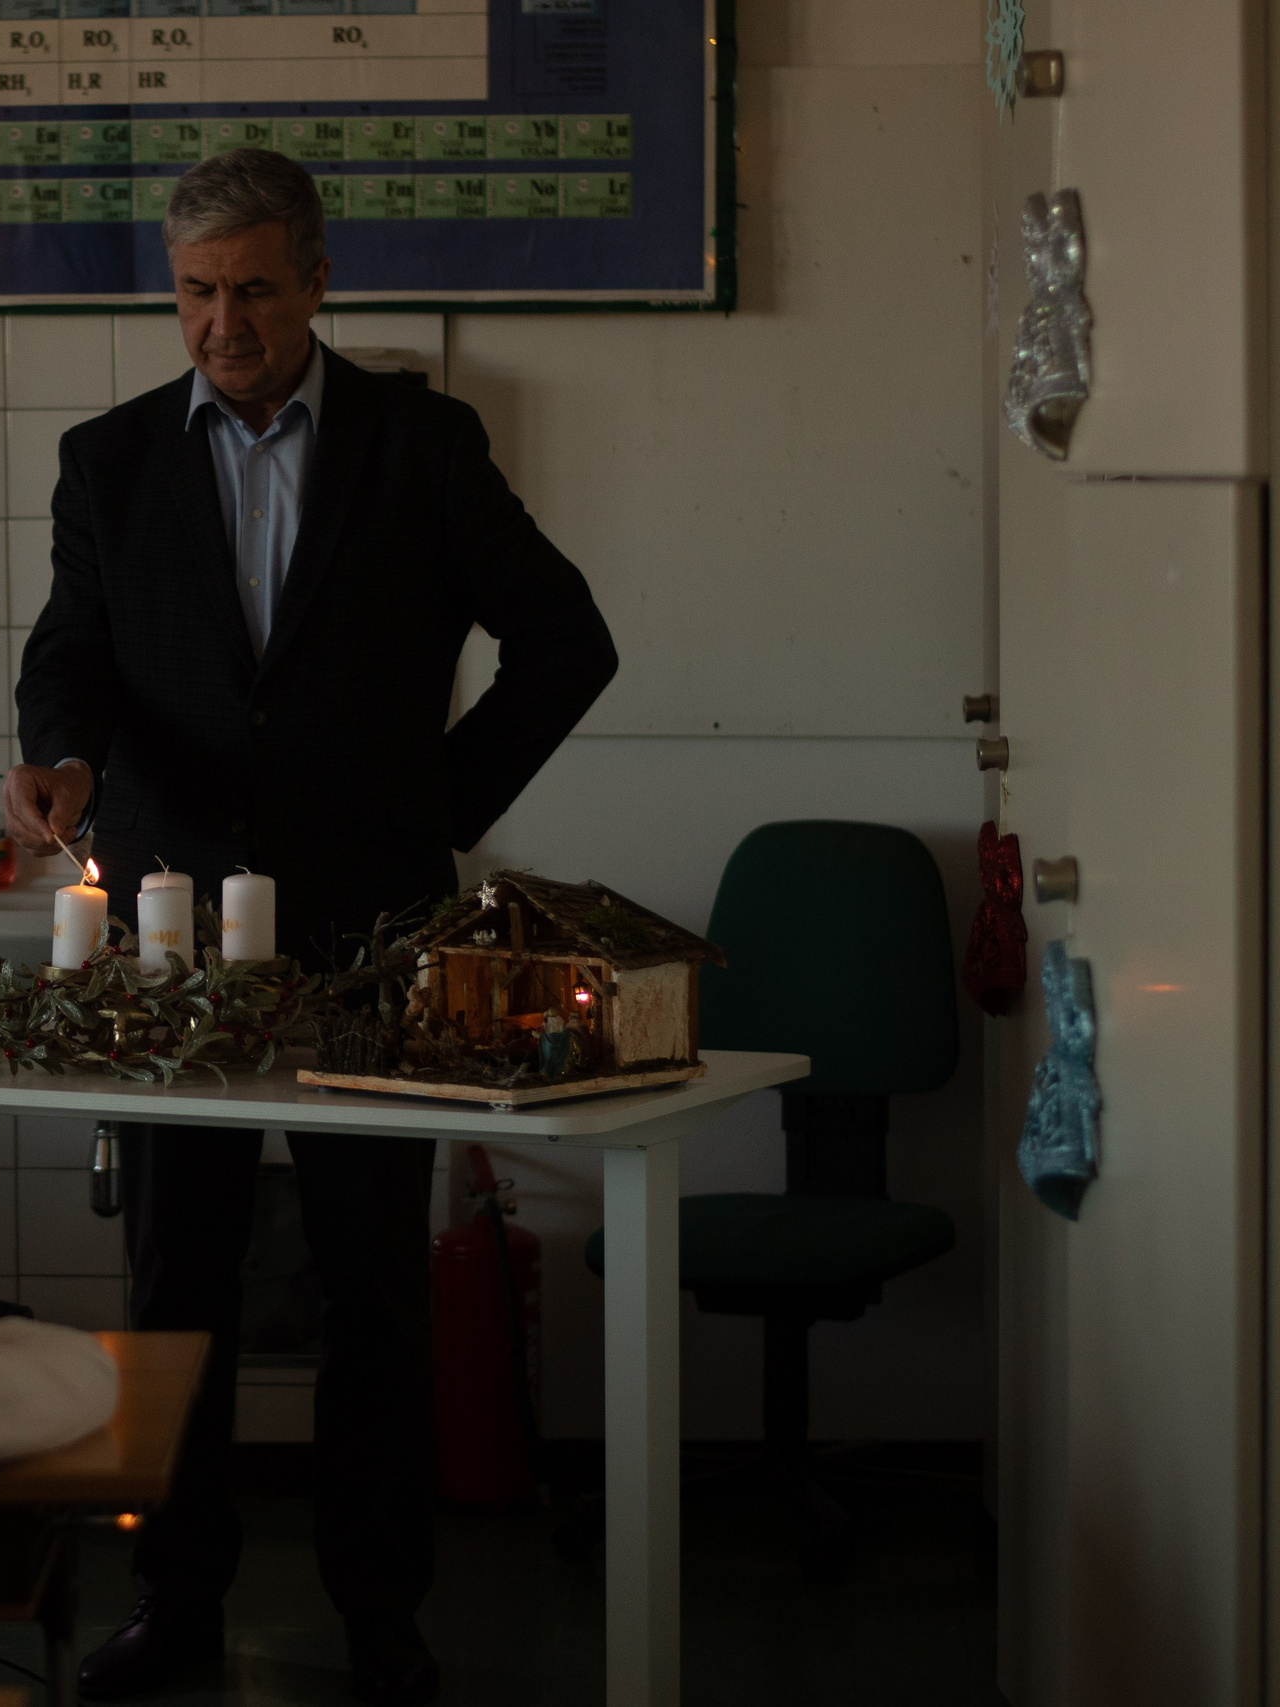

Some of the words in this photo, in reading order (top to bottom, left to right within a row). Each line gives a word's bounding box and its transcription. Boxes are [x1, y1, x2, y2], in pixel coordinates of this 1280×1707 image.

[138, 72, 166, 87] HR
[102, 125, 129, 142] Gd
[176, 124, 199, 141] Tb
[245, 124, 268, 144] Dy
[315, 123, 341, 139] Ho
[393, 122, 413, 138] Er
[455, 122, 484, 138] Tm
[533, 120, 555, 137] Yb
[100, 184, 128, 200] Cm
[322, 181, 341, 196] Es
[386, 180, 413, 196] Fm
[455, 179, 483, 195] Md
[530, 179, 556, 195] No
[608, 178, 626, 194] Lr
[149, 929, 181, 947] one
